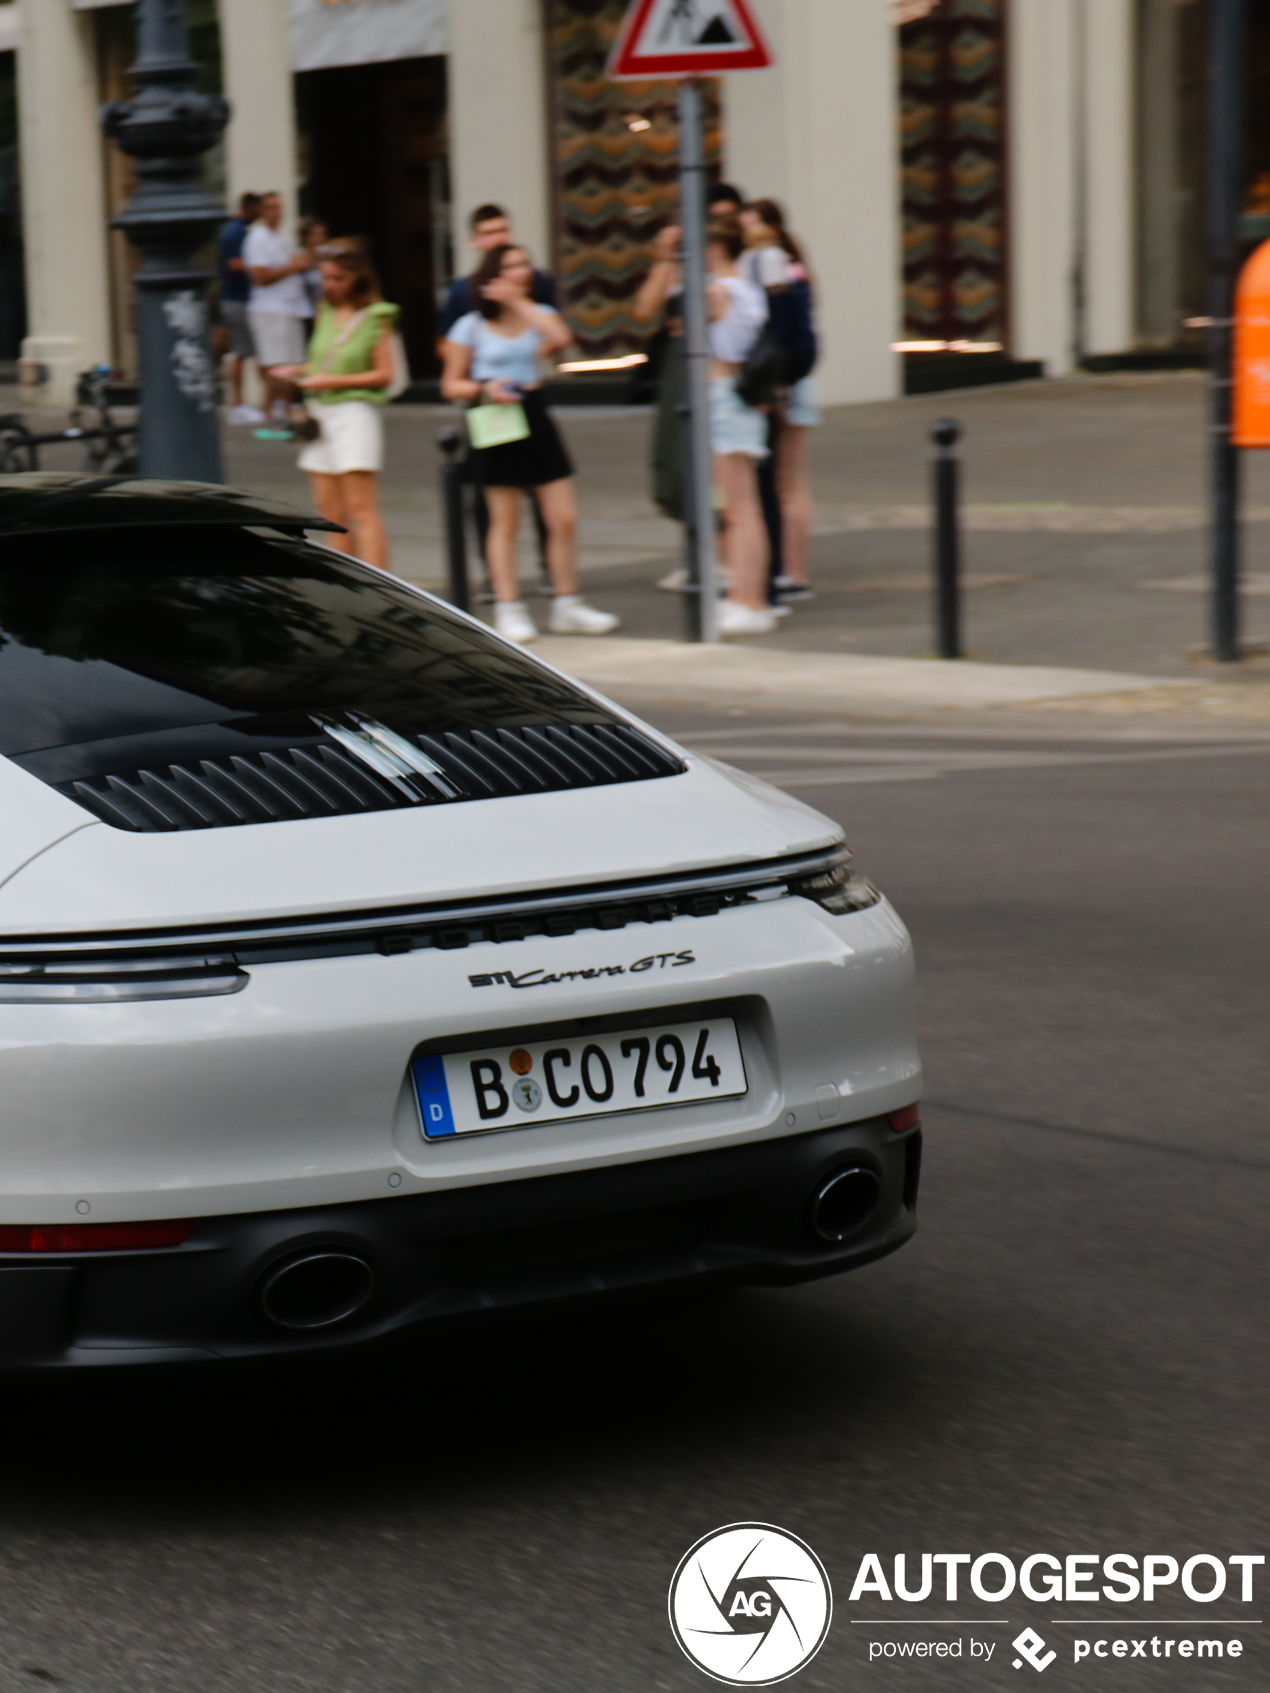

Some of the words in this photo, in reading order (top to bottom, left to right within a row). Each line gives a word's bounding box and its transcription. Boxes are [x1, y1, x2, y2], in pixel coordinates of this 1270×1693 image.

[511, 965, 627, 989] Carrera
[629, 950, 697, 973] GTS
[470, 1058, 510, 1120] B
[620, 1028, 721, 1097] 794
[430, 1104, 444, 1122] D
